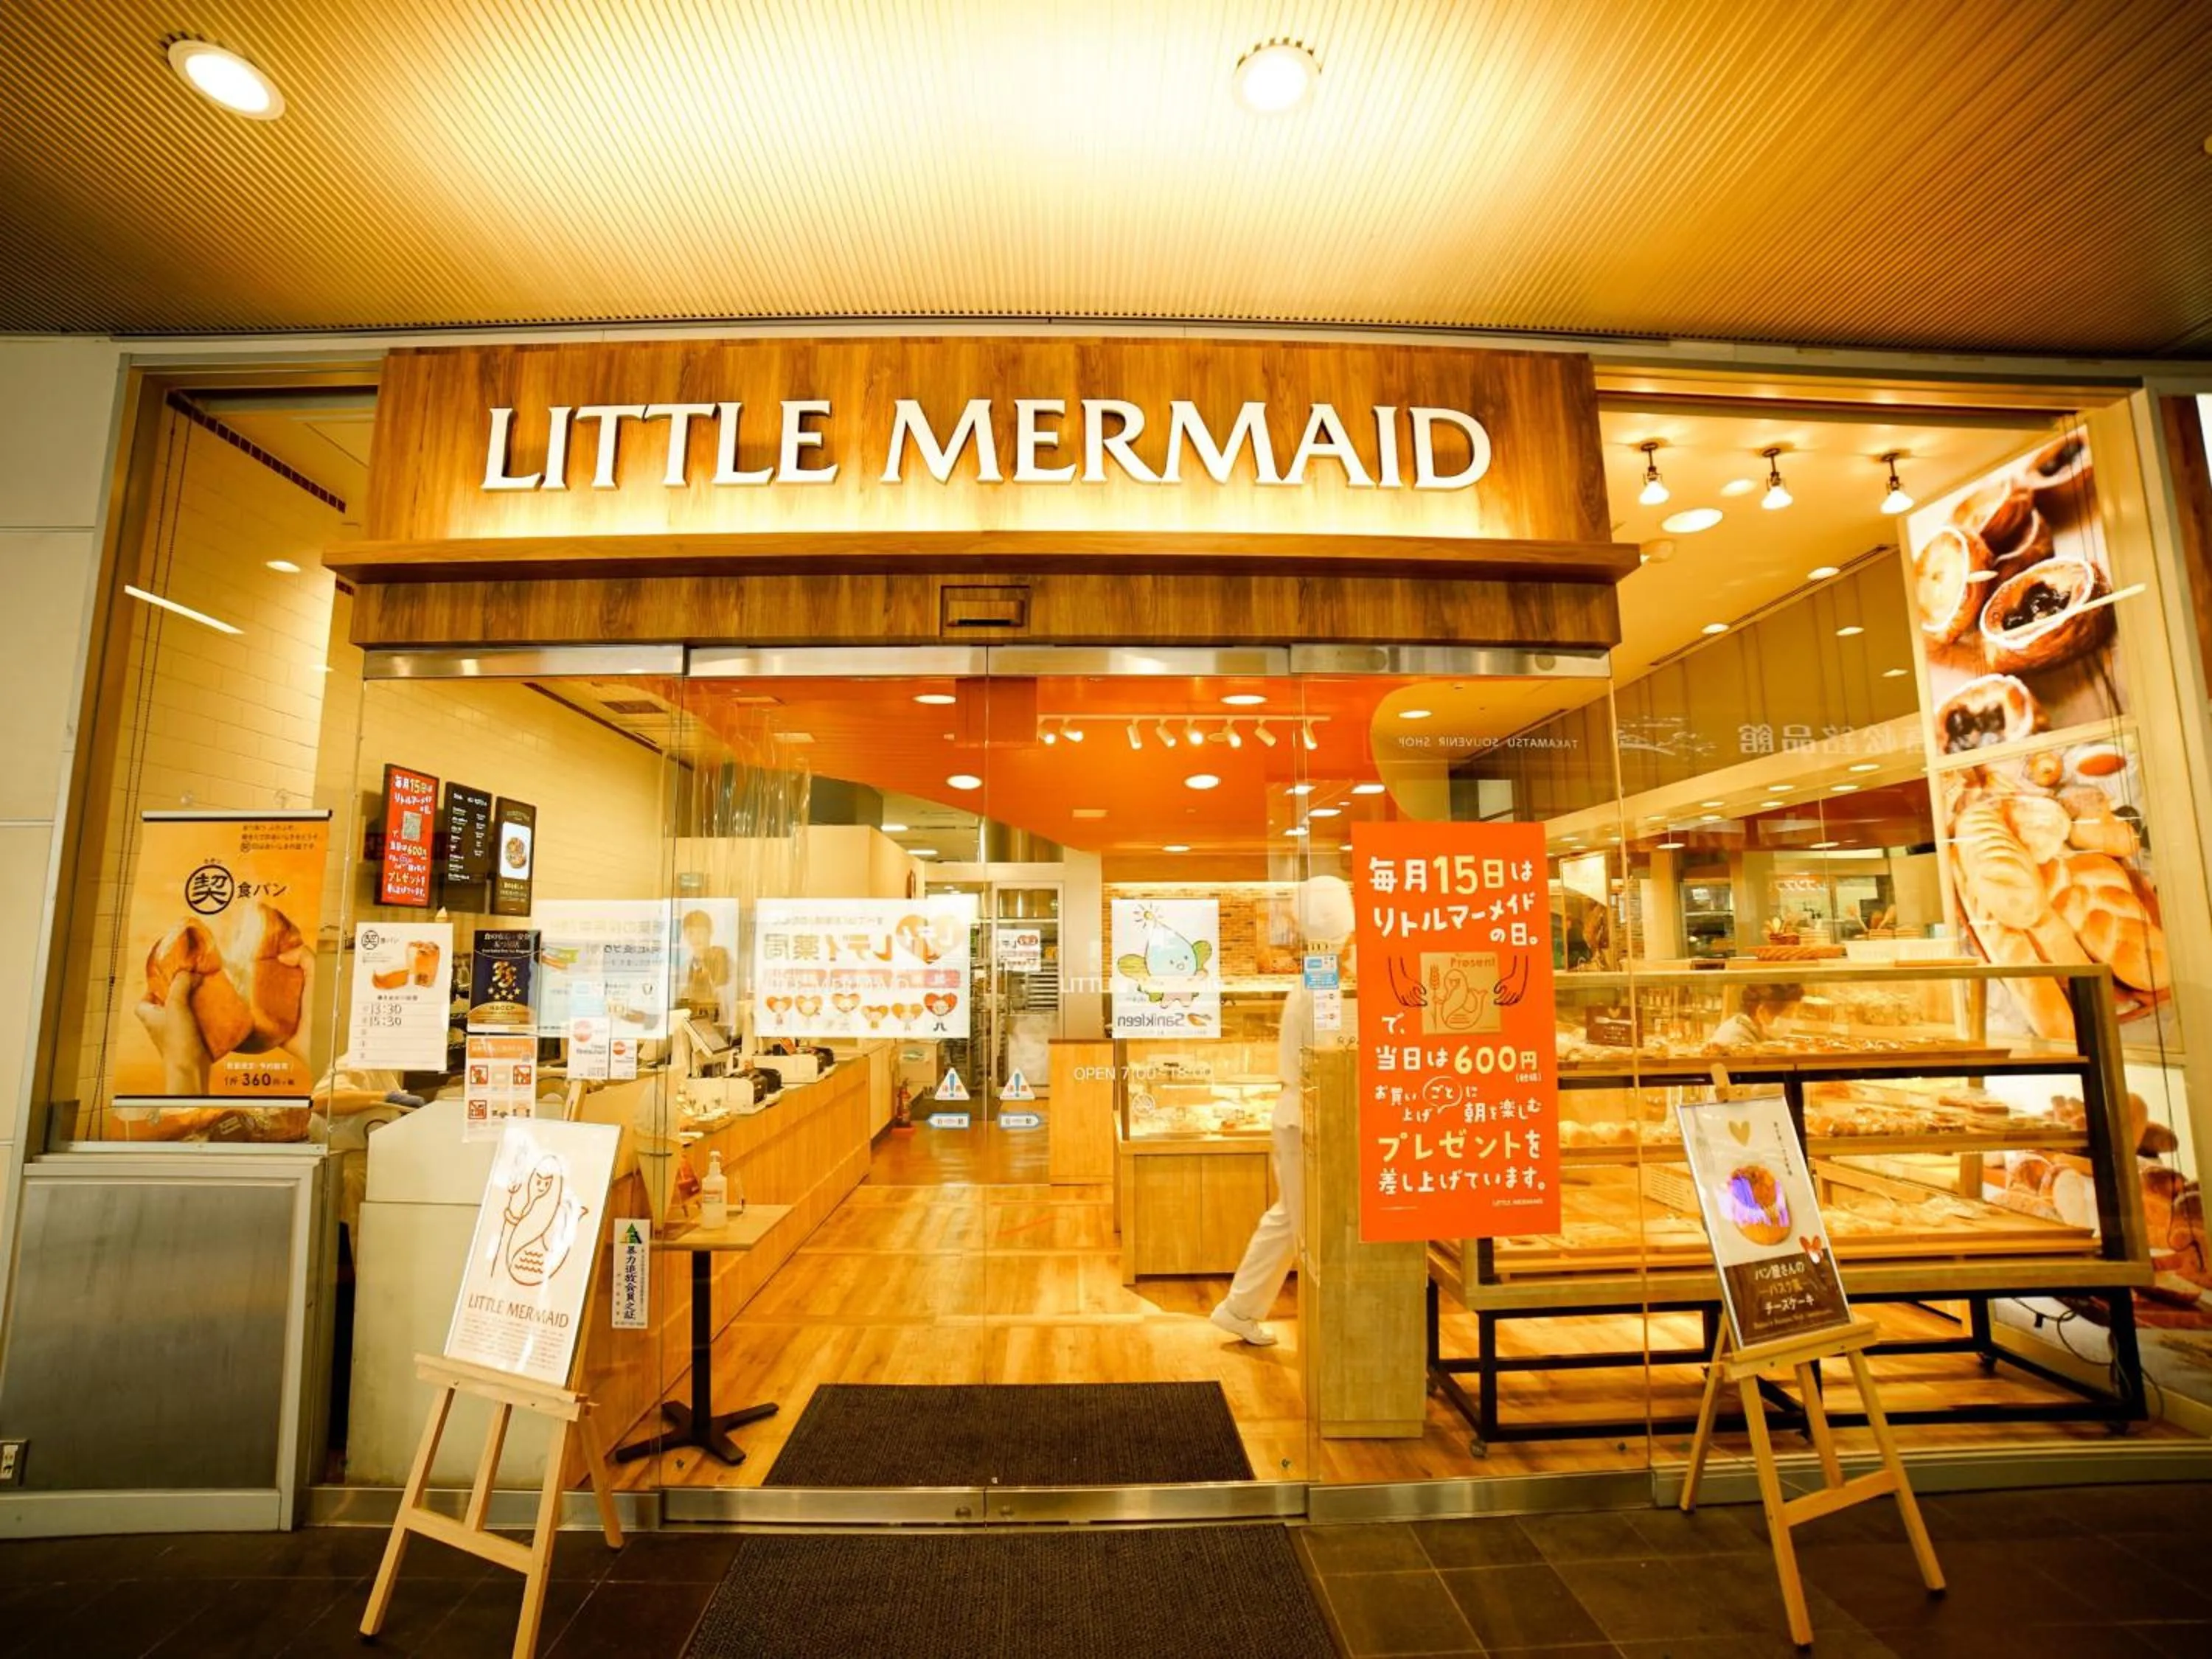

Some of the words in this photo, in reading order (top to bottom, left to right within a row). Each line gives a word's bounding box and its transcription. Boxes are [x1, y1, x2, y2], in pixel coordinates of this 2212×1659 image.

[481, 400, 839, 491] LITTLE
[880, 399, 1492, 491] MERMAID
[1369, 855, 1534, 895] 毎月15日は
[1373, 891, 1535, 937] リトルマーメイド
[1489, 922, 1539, 946] の日。
[1074, 1067, 1116, 1080] OPEN
[1375, 1044, 1537, 1074] 当日は600円
[1464, 1097, 1542, 1123] 朝を楽しむ
[1377, 1128, 1540, 1163] プレゼントを
[1378, 1166, 1546, 1195] 差し上げています。
[468, 1293, 502, 1315] LITTLE
[507, 1302, 569, 1328] MERMAID
